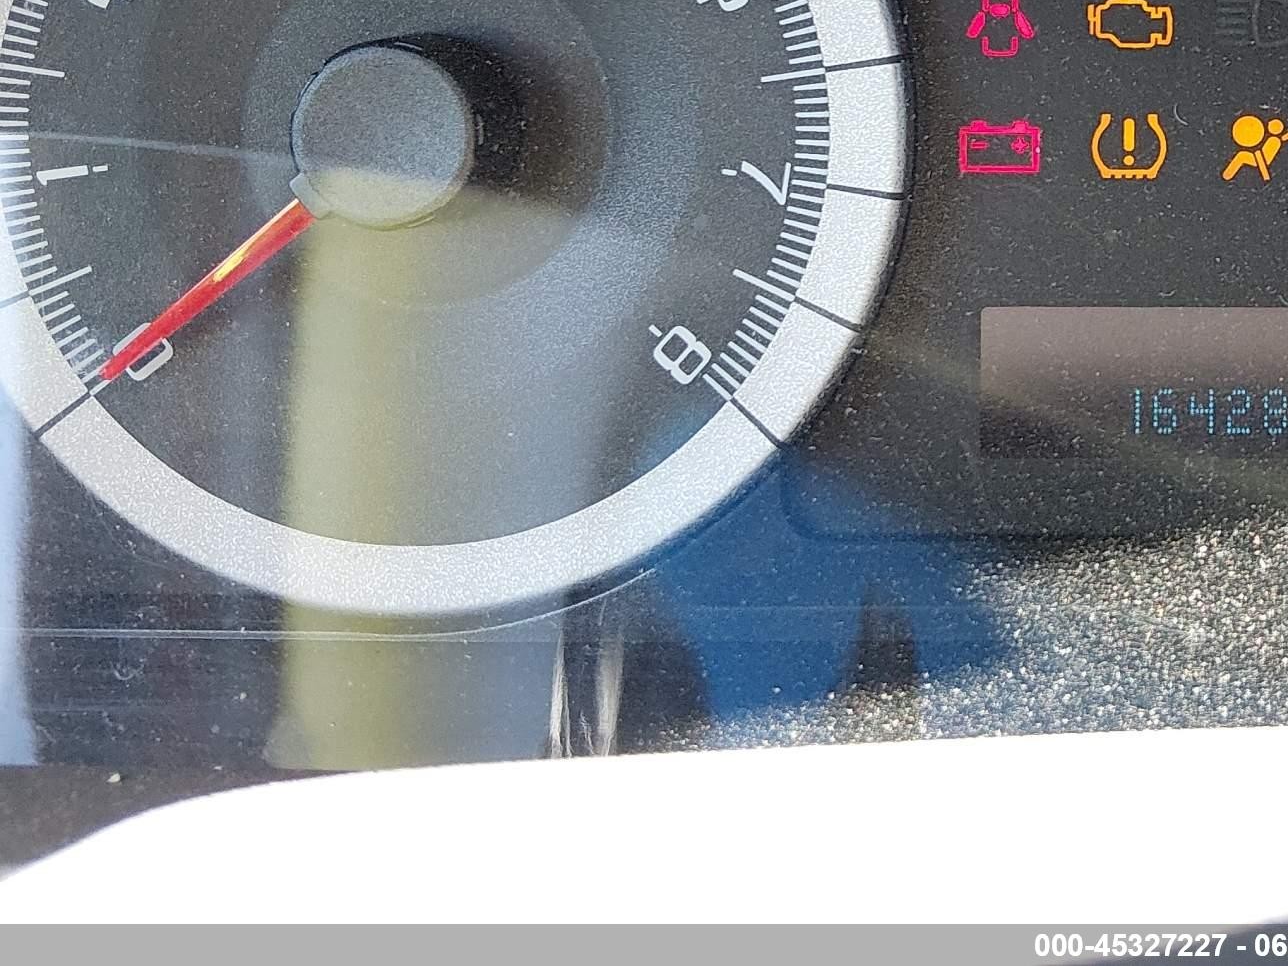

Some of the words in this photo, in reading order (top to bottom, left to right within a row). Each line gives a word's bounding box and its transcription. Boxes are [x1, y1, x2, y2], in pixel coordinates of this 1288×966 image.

[37, 165, 93, 185] 1
[741, 161, 793, 205] 7
[652, 324, 714, 383] 8
